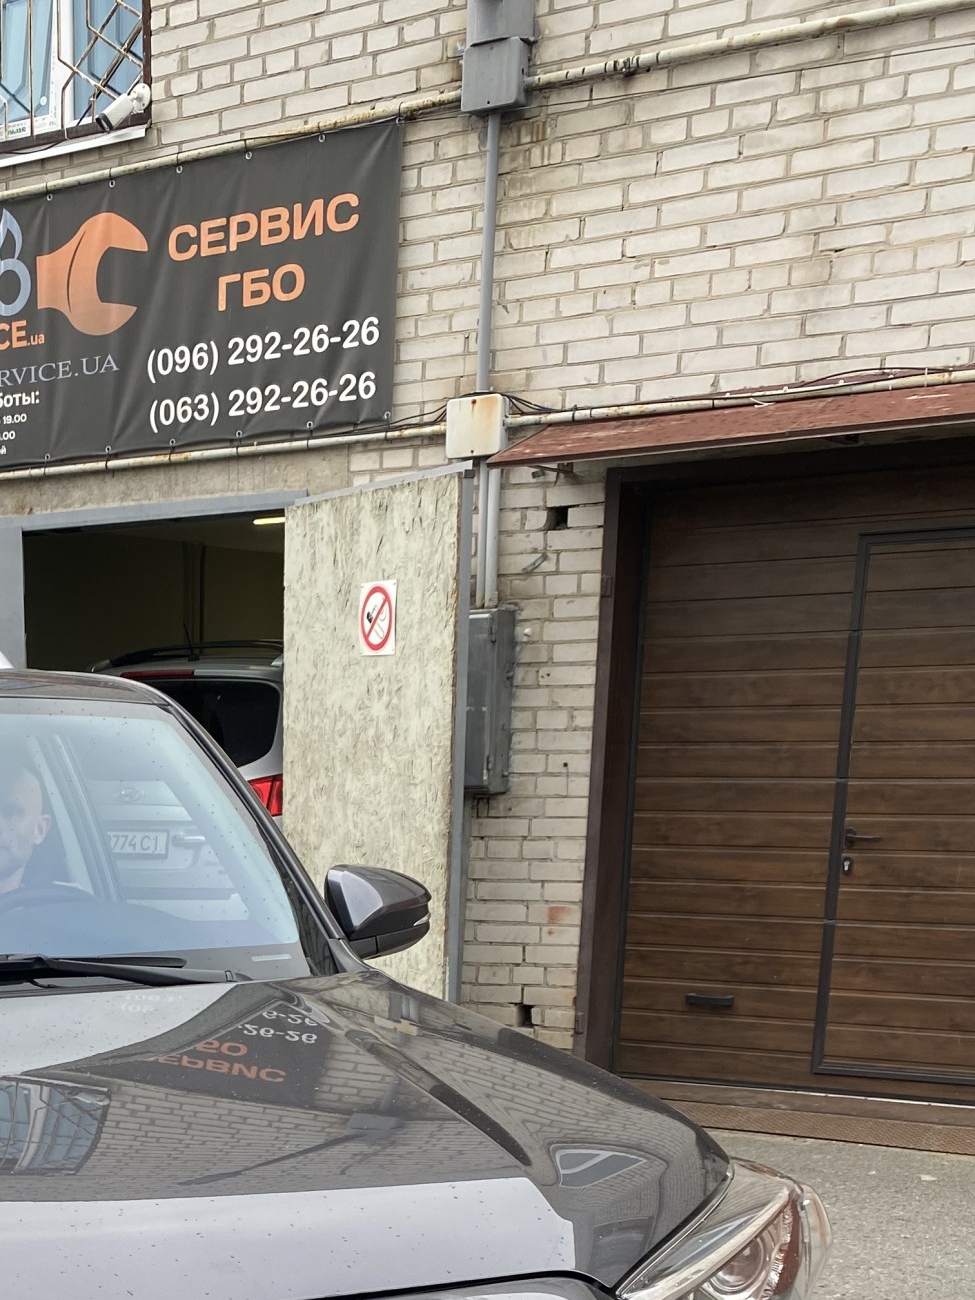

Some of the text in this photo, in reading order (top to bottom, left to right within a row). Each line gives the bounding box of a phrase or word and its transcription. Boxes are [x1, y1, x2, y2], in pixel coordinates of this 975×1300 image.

[168, 192, 361, 263] СЕРВИС
[217, 263, 306, 312] ГБО
[146, 316, 380, 384] (096) 292-26-26
[149, 371, 376, 433] (063) 292-26-26
